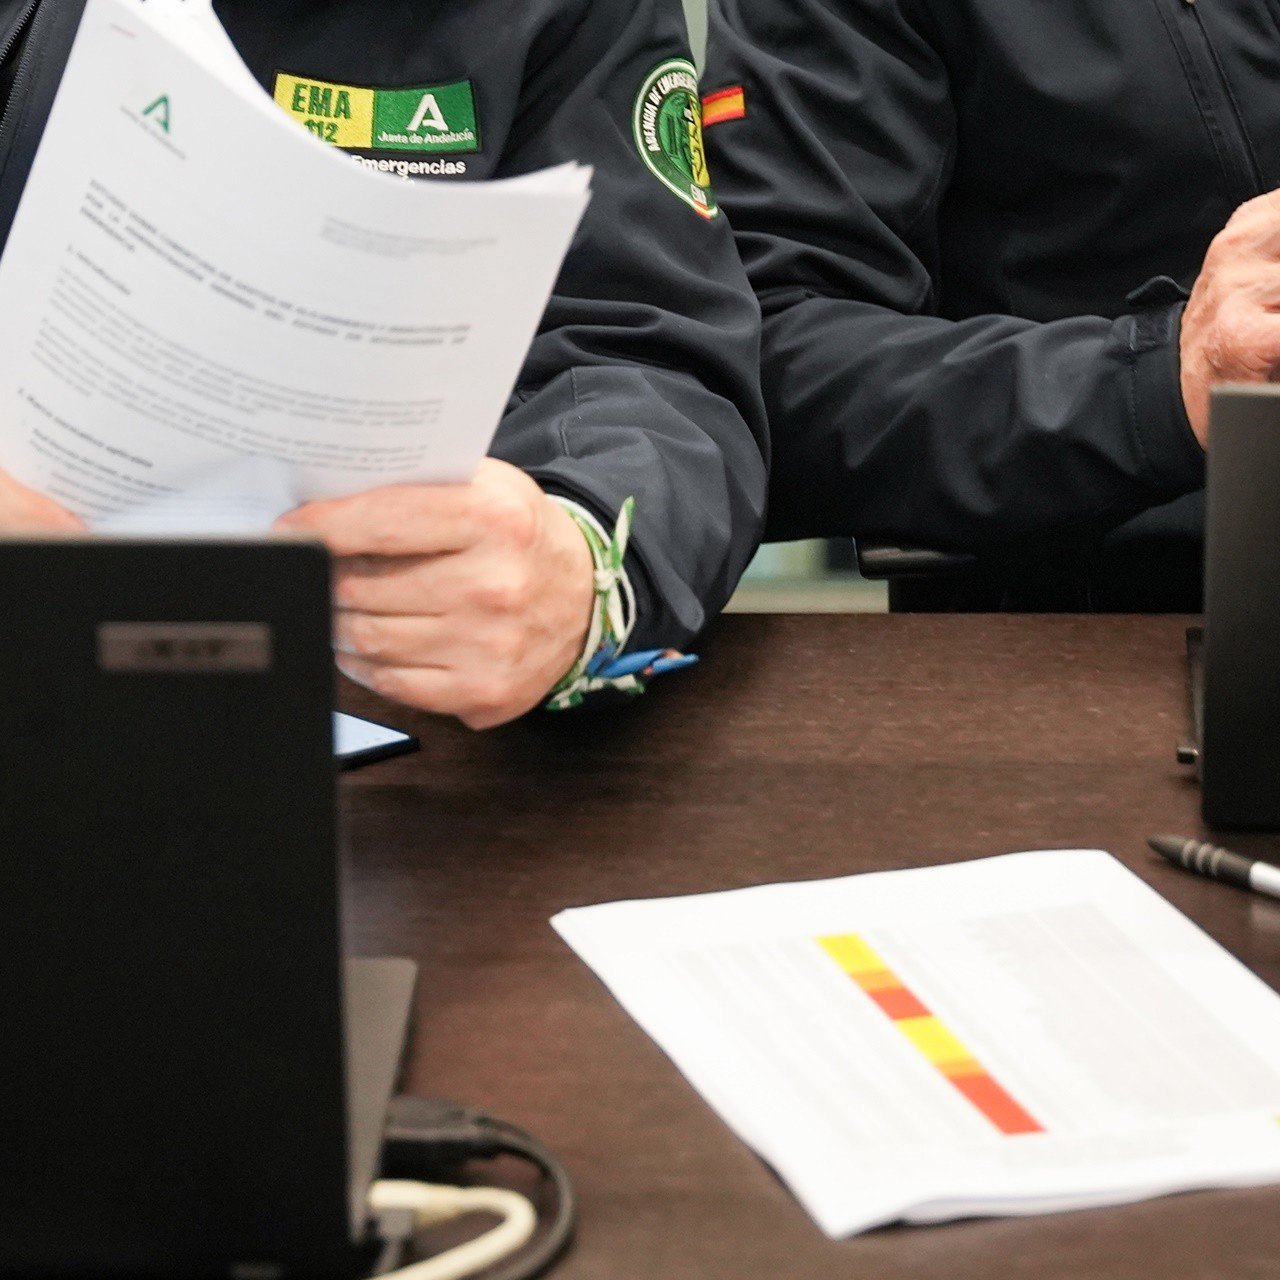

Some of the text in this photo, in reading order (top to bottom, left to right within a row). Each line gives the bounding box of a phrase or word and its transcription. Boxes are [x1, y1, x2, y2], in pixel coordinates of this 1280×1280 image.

[292, 82, 351, 119] EMA
[378, 131, 408, 144] Junta
[409, 132, 423, 144] de
